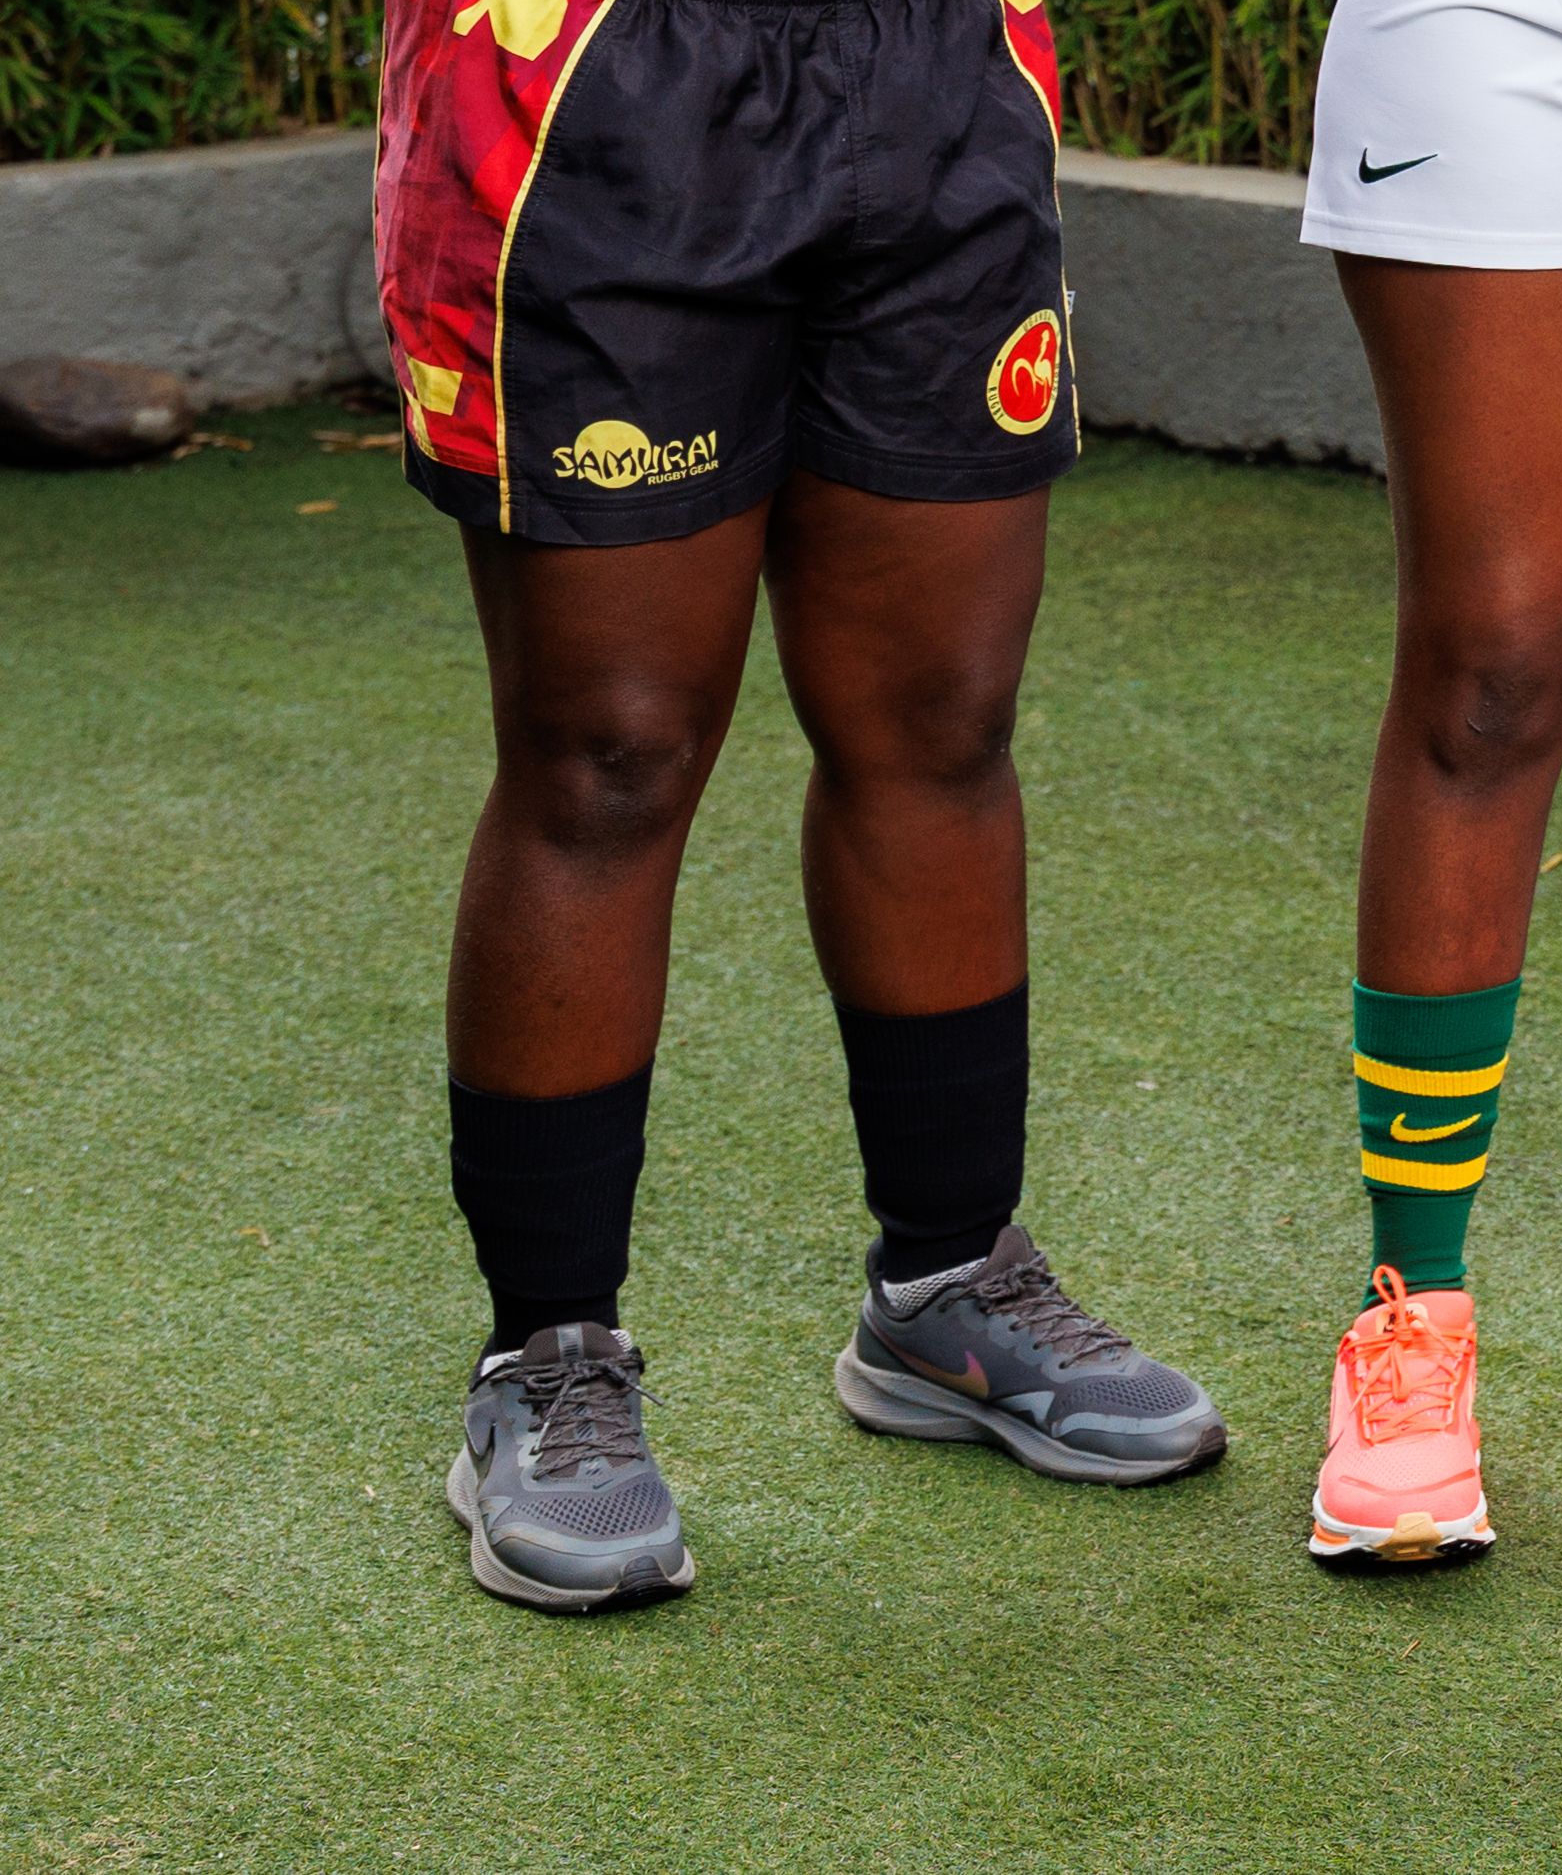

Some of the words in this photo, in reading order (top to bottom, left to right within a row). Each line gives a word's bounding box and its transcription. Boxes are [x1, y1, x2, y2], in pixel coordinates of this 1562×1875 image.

[988, 386, 1005, 422] RUGBY
[552, 430, 717, 480] SAMURAI
[647, 469, 687, 485] RUGBY
[689, 460, 719, 476] GEAR
